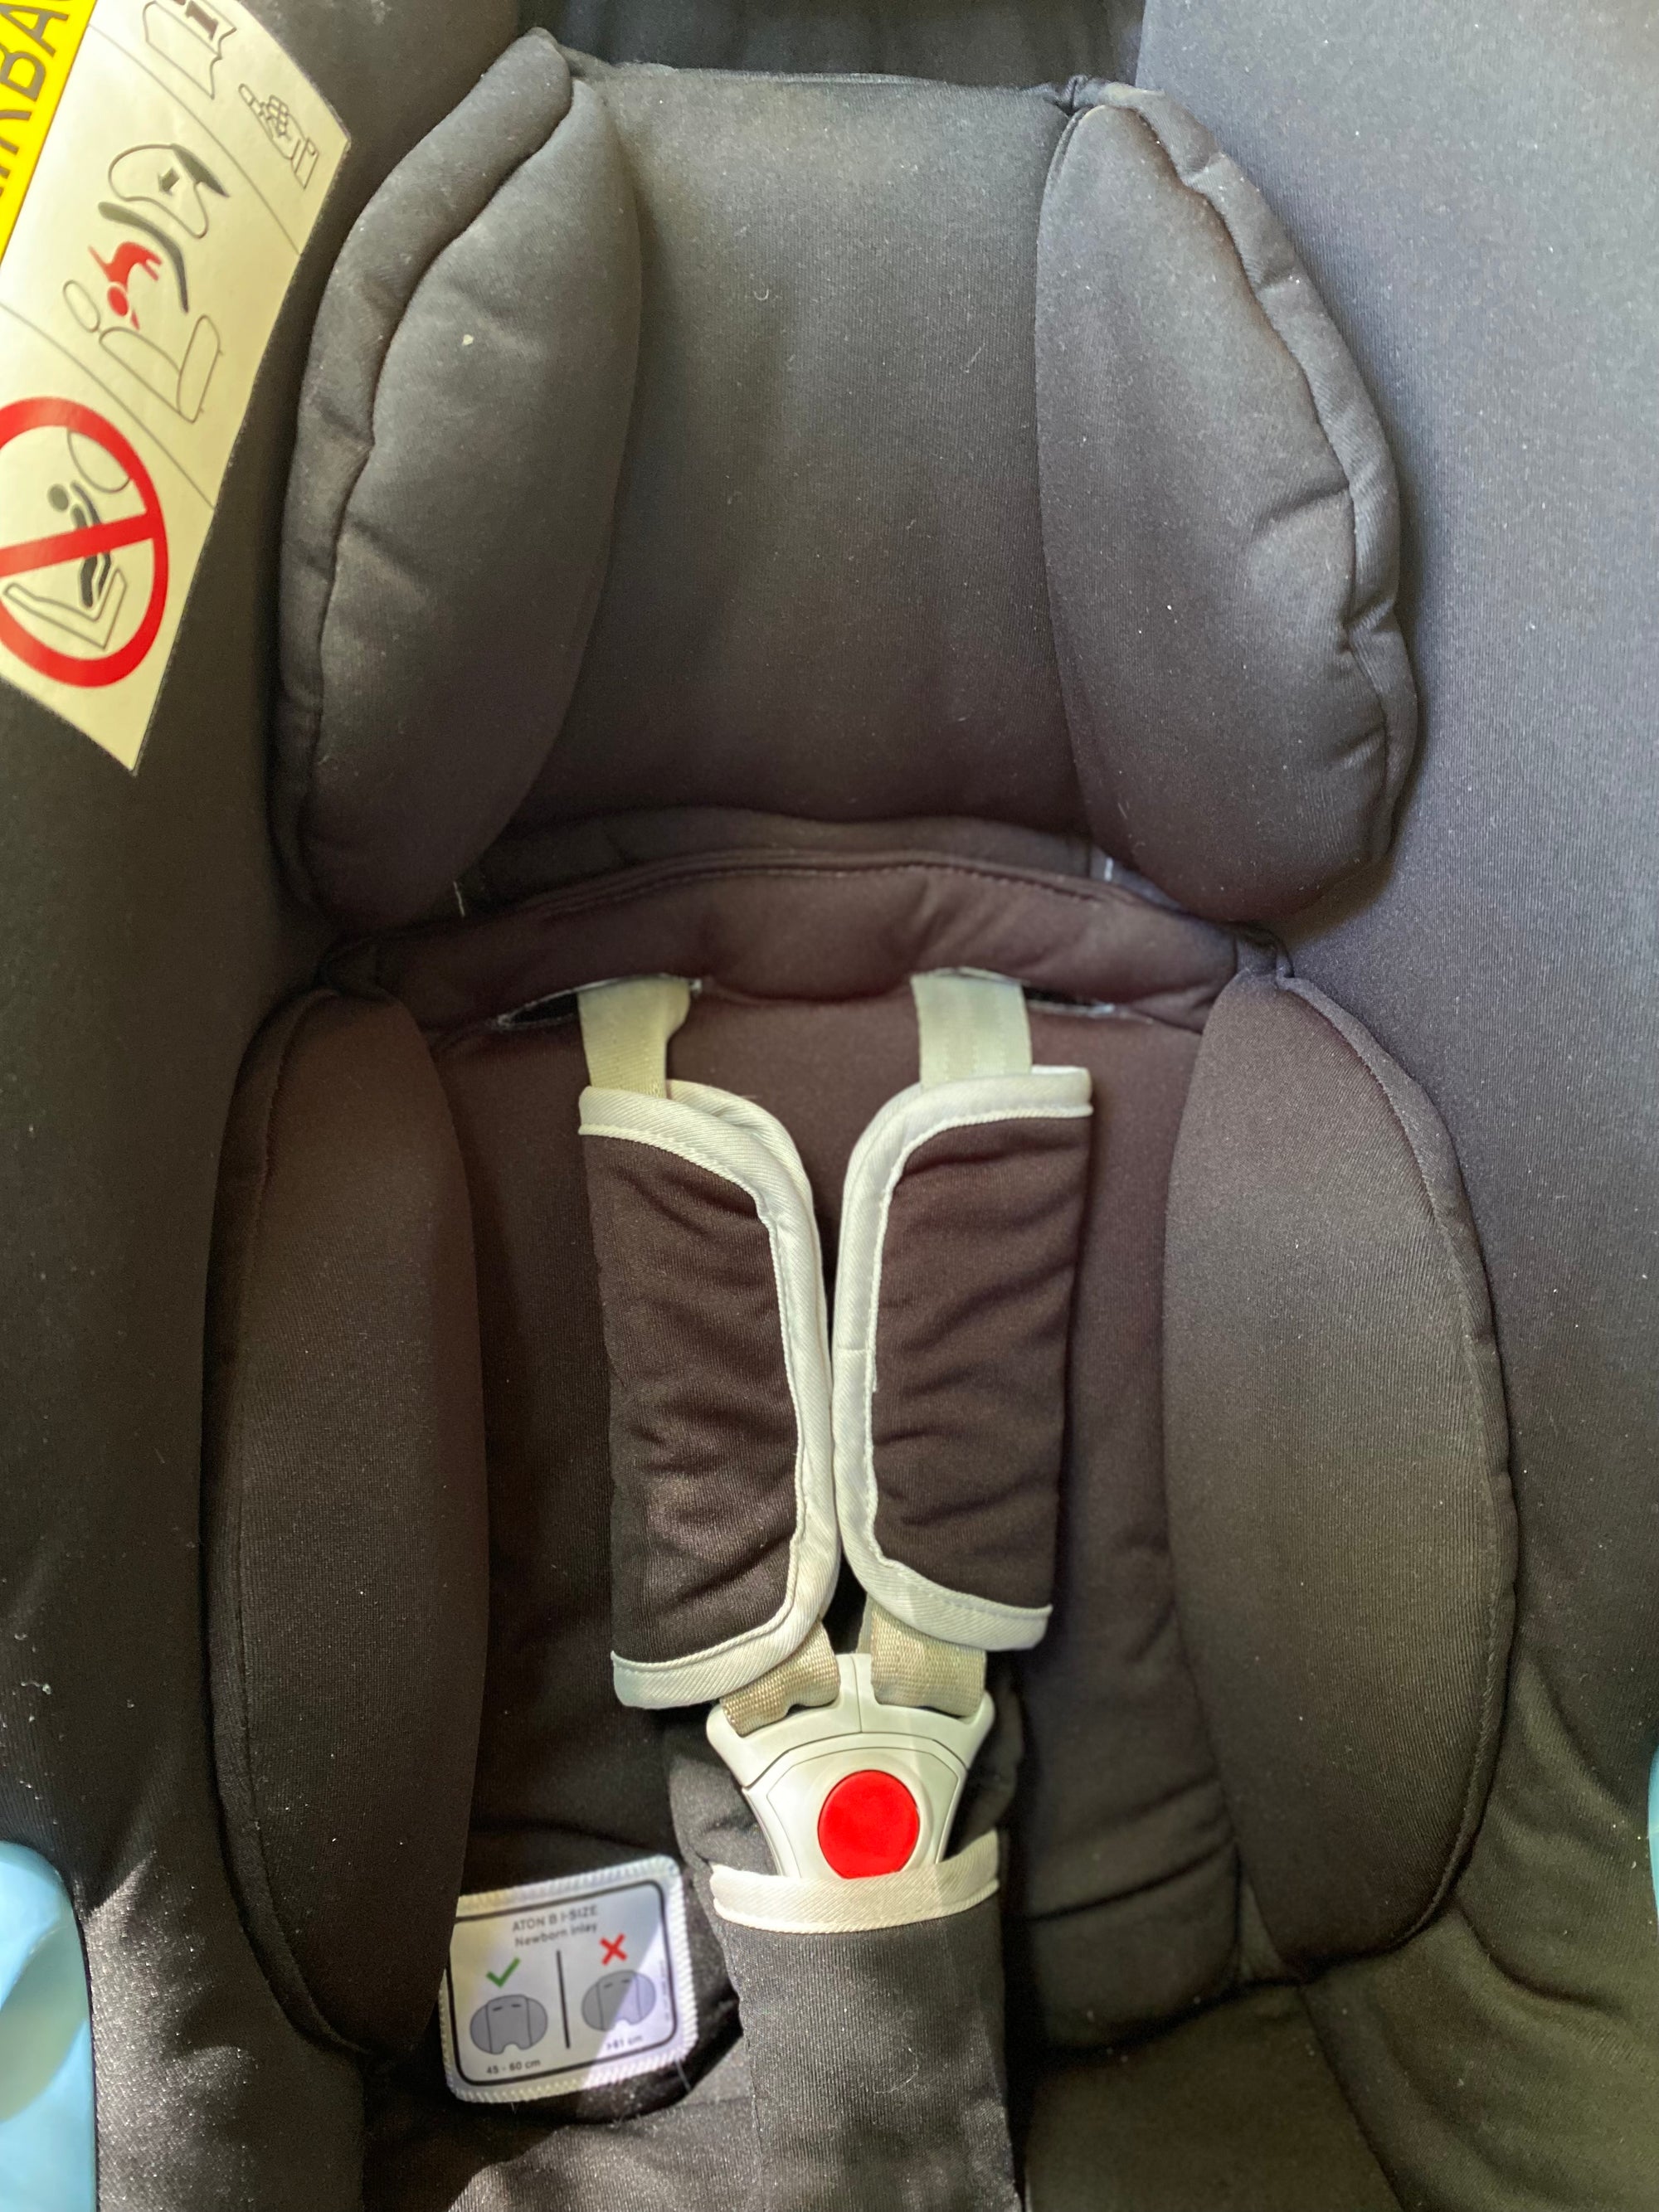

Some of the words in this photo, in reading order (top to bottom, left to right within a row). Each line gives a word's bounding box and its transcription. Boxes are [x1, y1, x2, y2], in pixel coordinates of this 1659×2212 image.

[513, 1917, 545, 1932] ATON
[515, 1928, 567, 1947] Newborn
[486, 2064, 499, 2074] 45
[508, 2060, 523, 2072] 60
[524, 2059, 541, 2069] cm
